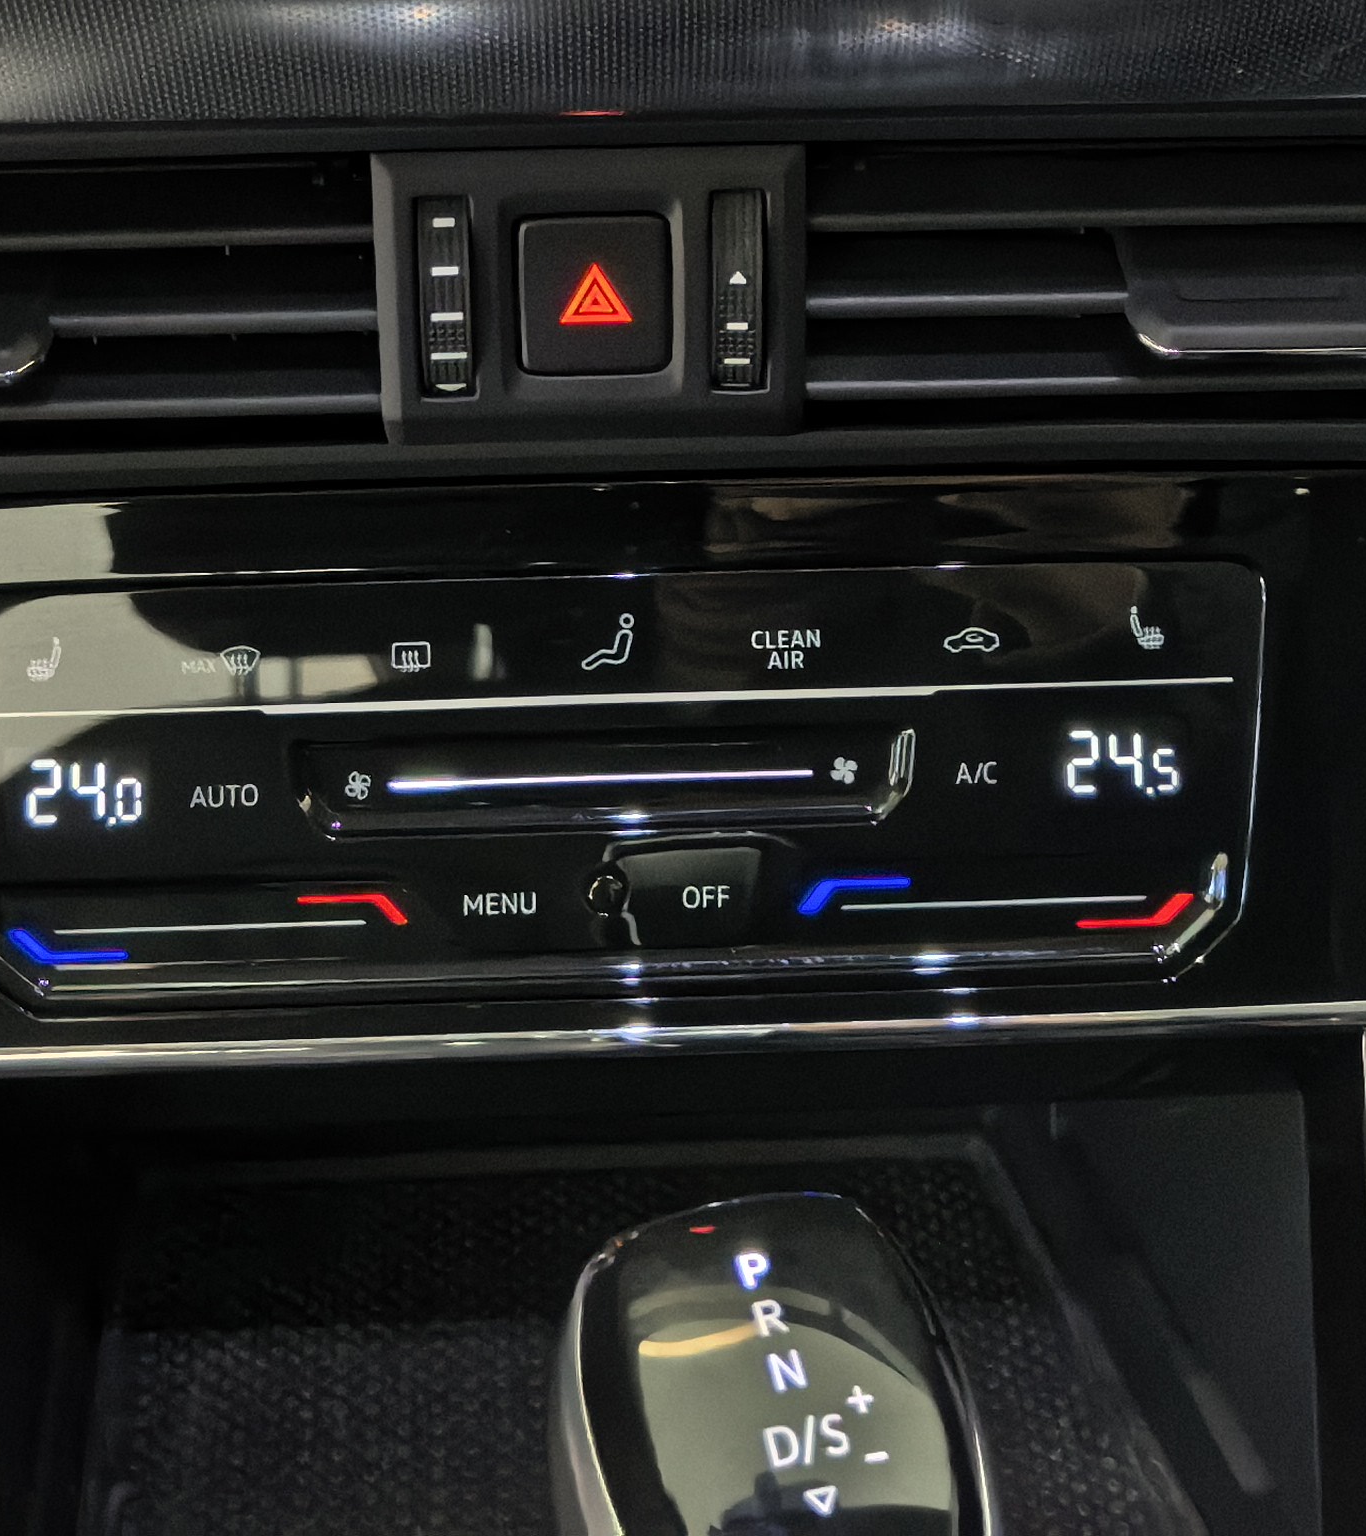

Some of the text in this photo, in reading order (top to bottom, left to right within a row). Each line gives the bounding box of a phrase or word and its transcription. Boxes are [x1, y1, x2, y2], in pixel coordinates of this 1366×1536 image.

[750, 628, 822, 651] CLEAN
[180, 658, 217, 675] MAX
[767, 650, 805, 670] AIR
[954, 760, 999, 786] A/C
[1066, 729, 1181, 797] 24.5
[24, 758, 143, 828] 24.0
[189, 783, 260, 809] AUTO
[462, 890, 539, 917] MENU
[681, 885, 731, 910] OFF
[734, 1251, 771, 1291] P
[751, 1298, 790, 1338] R
[766, 1348, 809, 1393] N
